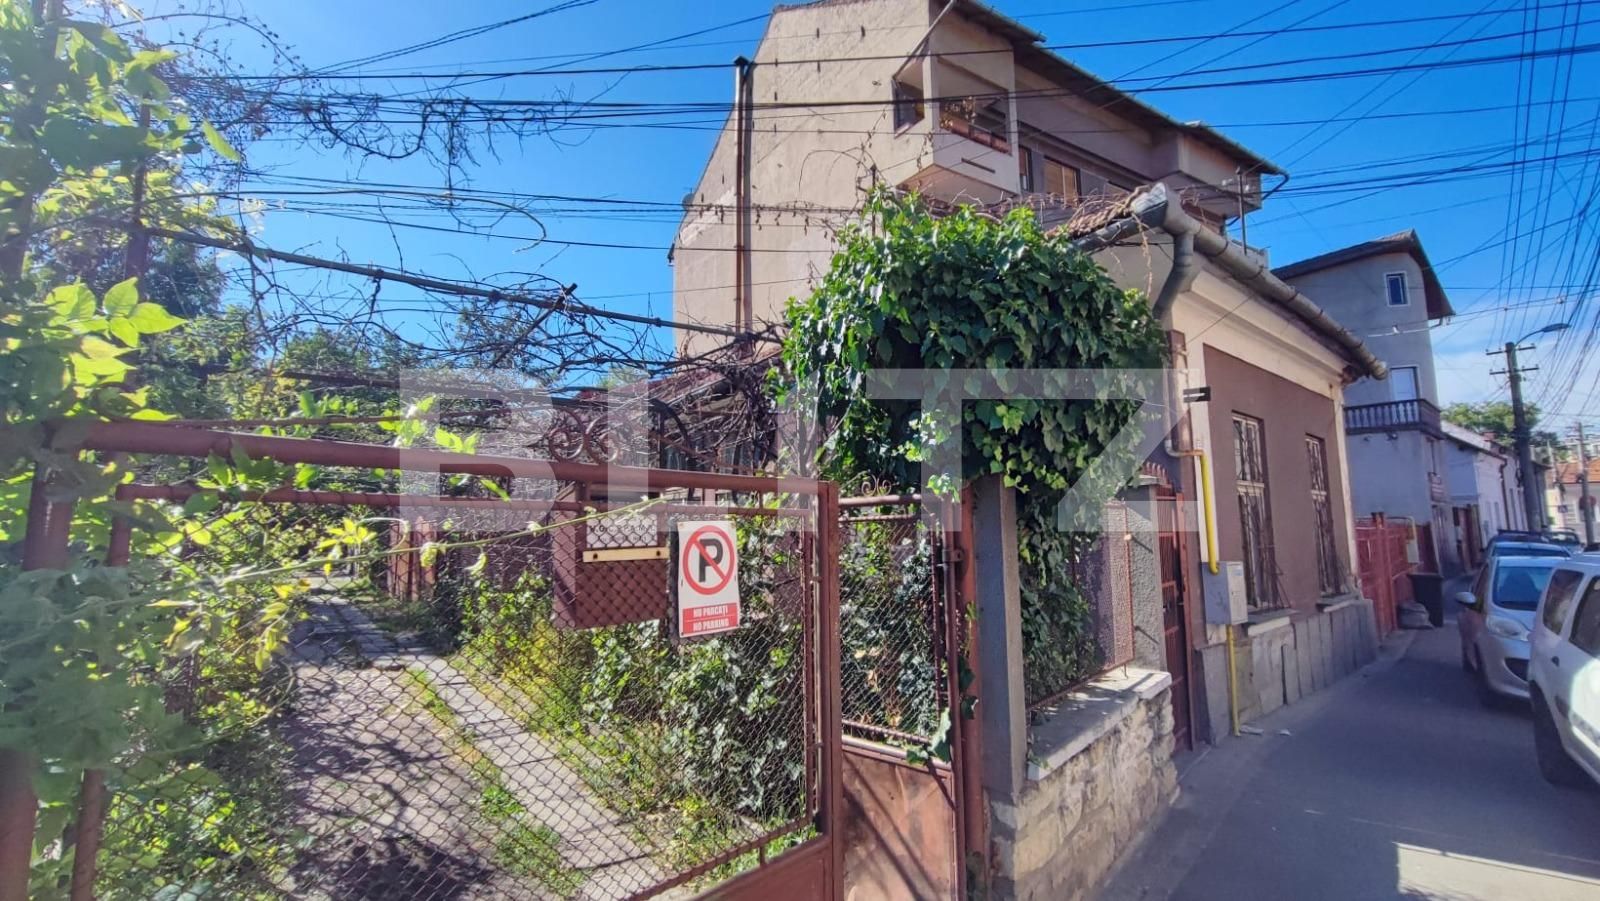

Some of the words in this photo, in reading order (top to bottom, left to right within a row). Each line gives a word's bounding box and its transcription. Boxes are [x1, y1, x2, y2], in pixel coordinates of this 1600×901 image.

[699, 538, 724, 583] P
[693, 608, 702, 618] NU
[693, 622, 702, 632] NO
[703, 618, 729, 631] PARKING
